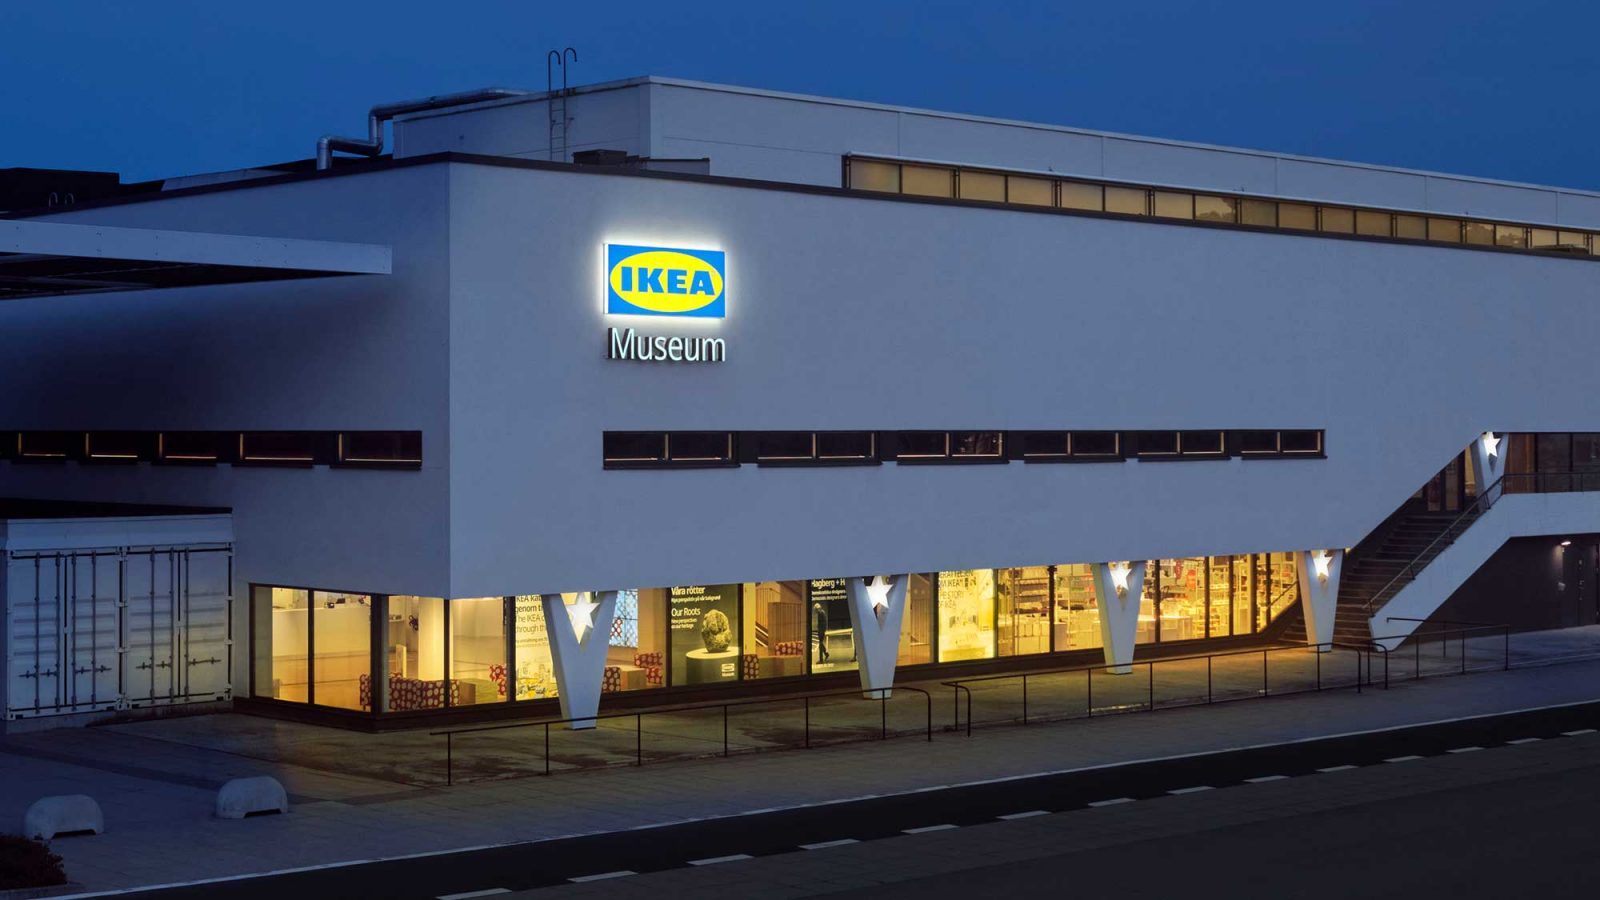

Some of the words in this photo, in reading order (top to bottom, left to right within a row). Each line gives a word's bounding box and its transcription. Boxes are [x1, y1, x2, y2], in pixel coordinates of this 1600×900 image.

[620, 266, 715, 296] IKEA
[609, 327, 726, 362] Museum
[671, 608, 684, 617] Our
[683, 607, 701, 616] Roots
